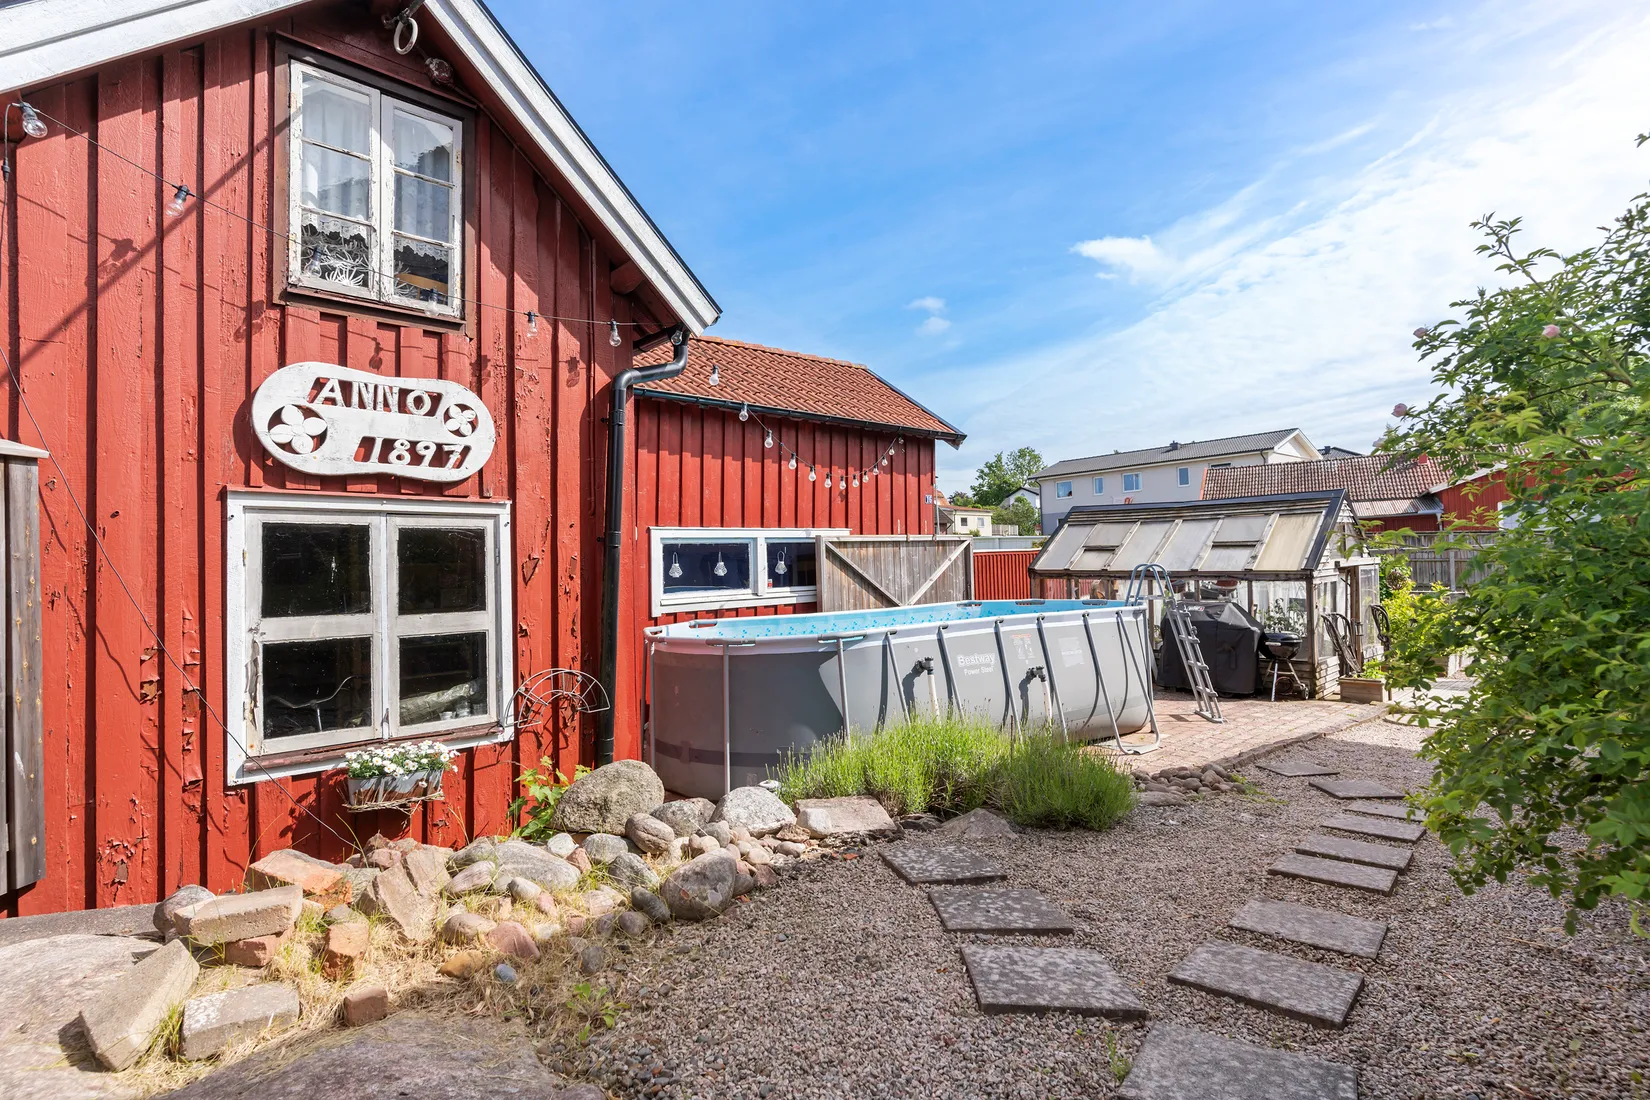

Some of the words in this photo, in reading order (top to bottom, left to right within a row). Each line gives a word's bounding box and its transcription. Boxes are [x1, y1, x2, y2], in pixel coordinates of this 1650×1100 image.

[314, 378, 432, 416] ANNO
[368, 436, 464, 470] 1897
[957, 653, 995, 666] Bestway
[964, 668, 980, 676] Power
